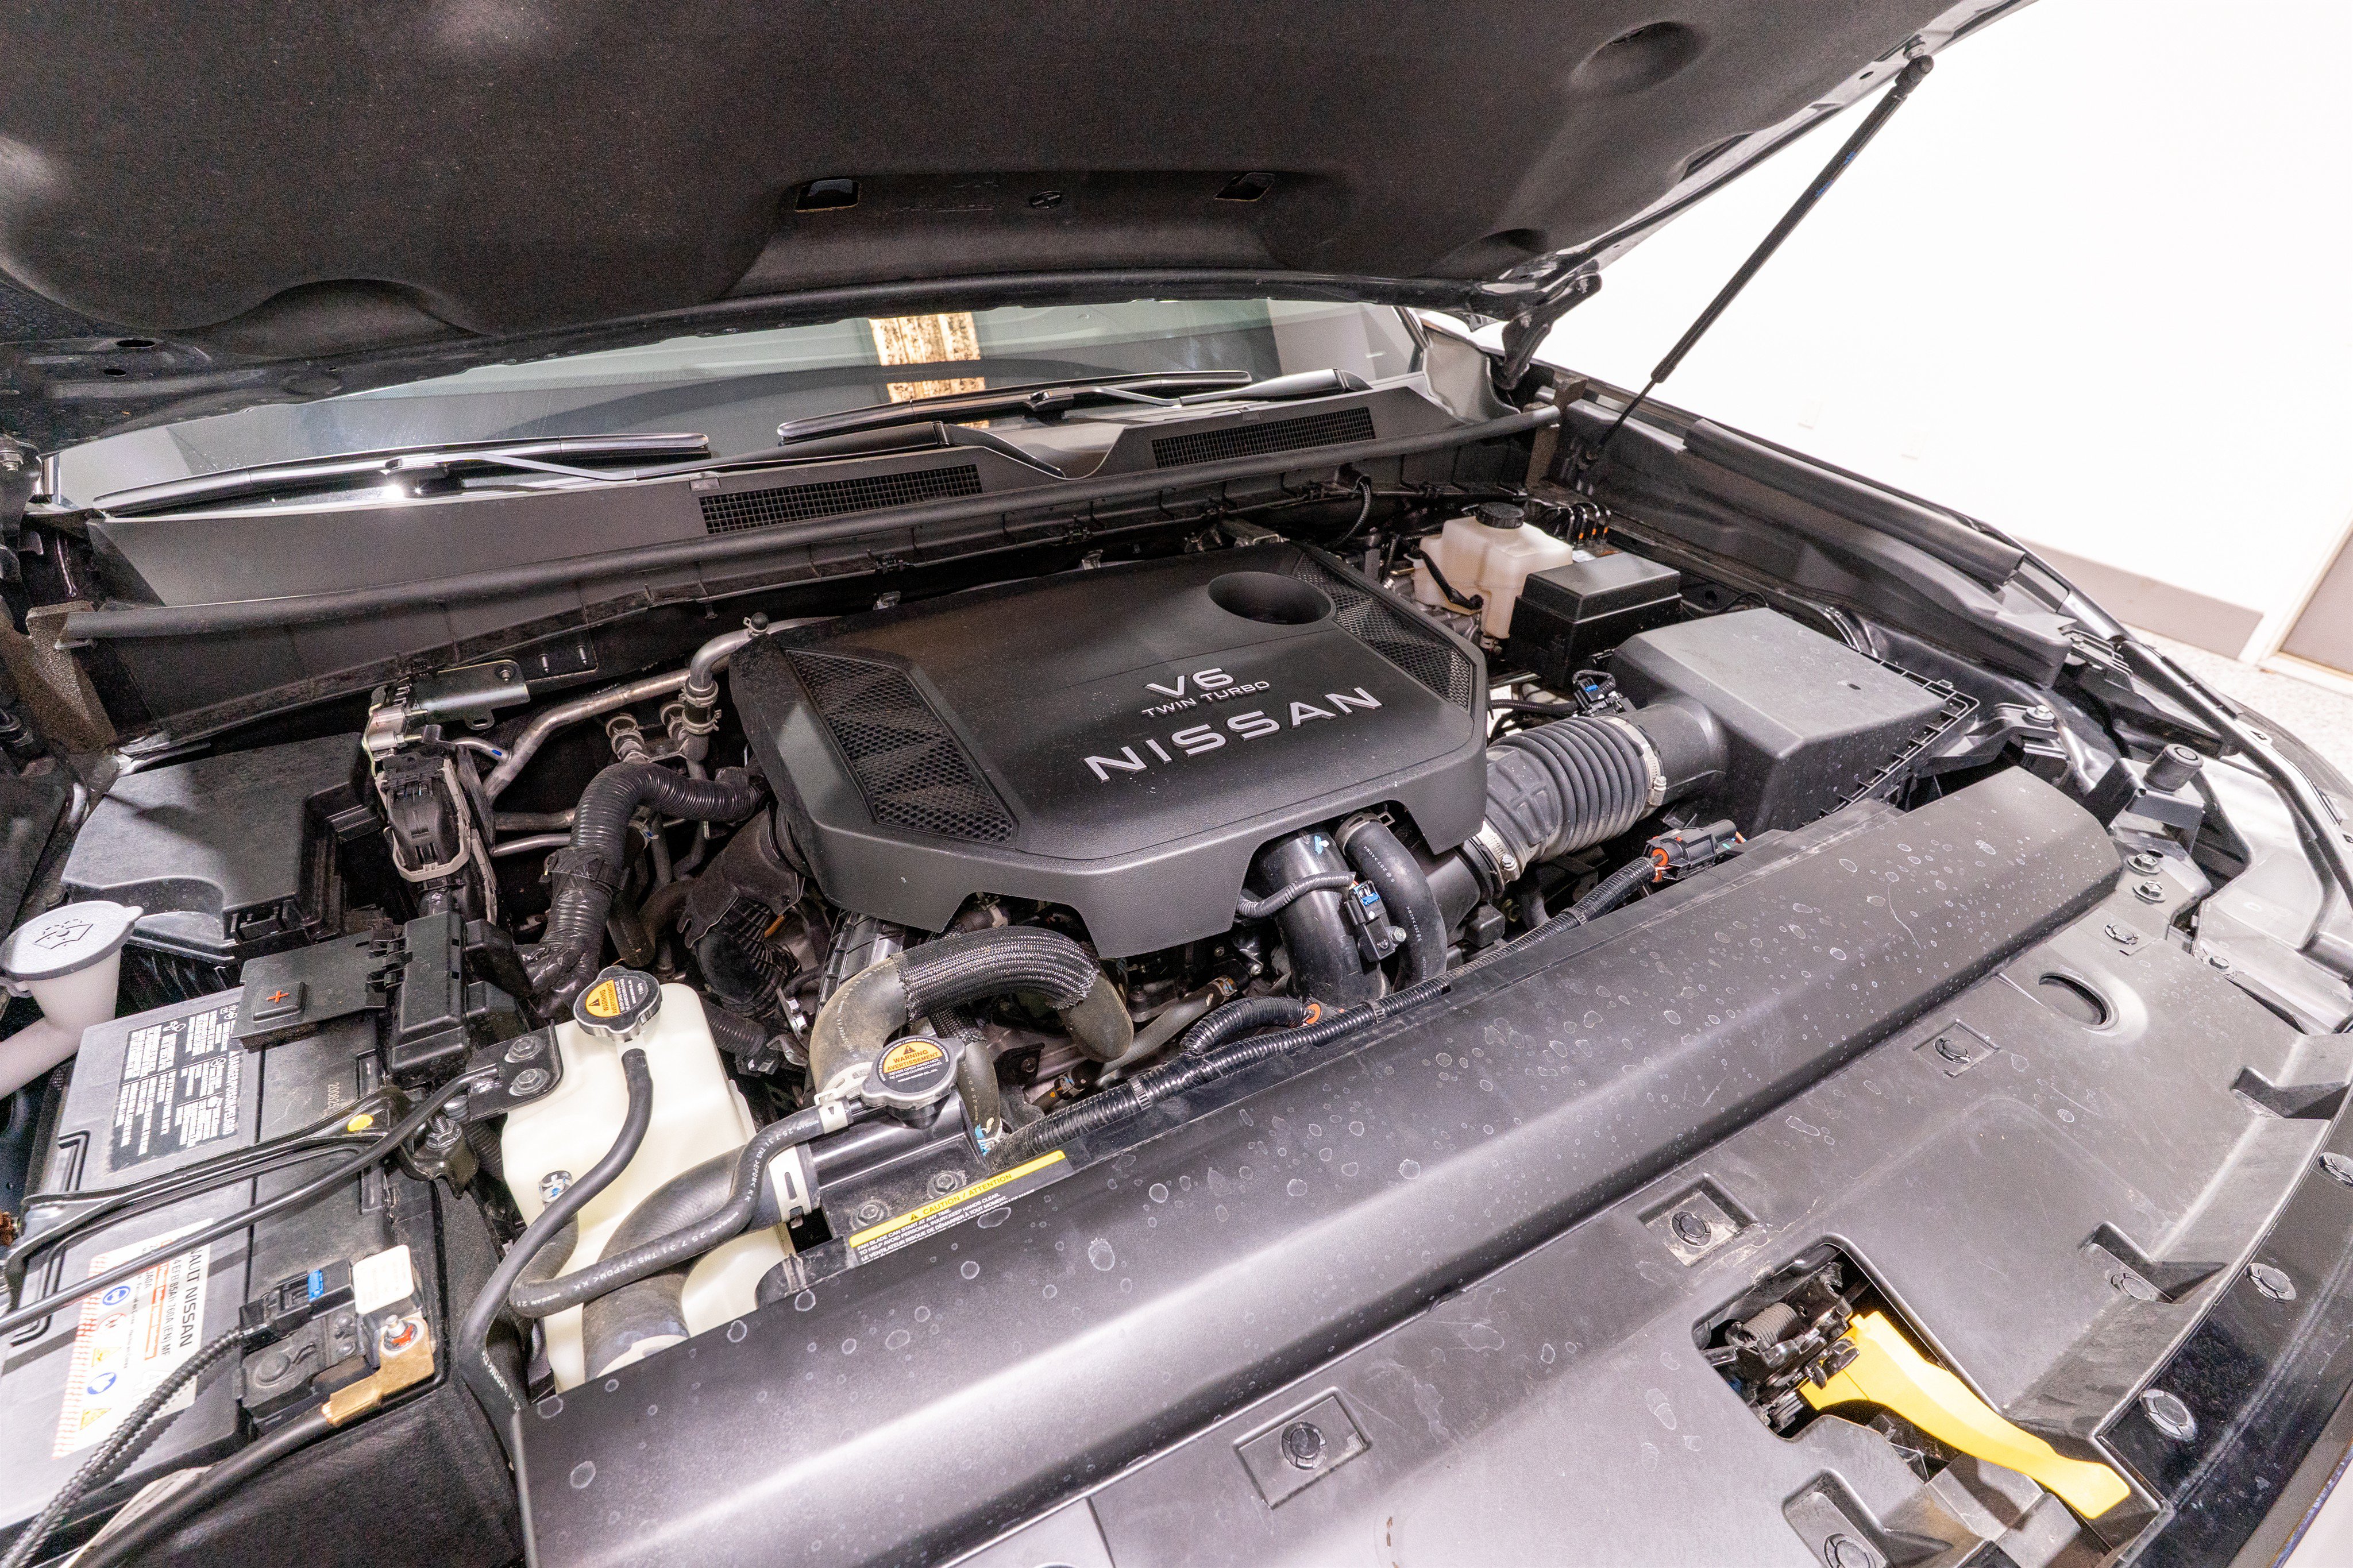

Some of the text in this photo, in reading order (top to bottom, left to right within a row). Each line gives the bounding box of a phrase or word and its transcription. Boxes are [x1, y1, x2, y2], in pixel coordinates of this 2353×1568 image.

[1144, 668, 1235, 698] V6
[1141, 681, 1270, 718] TWIN TURBO
[1083, 688, 1383, 783] NISSAN
[600, 989, 609, 1011] WARNING
[607, 983, 618, 1014] AVERTISSEMENT
[887, 1052, 938, 1071] AVERTISSEMENT
[893, 1049, 928, 1063] WARNING
[327, 1082, 340, 1109] 200825
[783, 1128, 793, 1137] 25
[796, 1119, 819, 1130] NISSAN
[756, 1147, 766, 1159] TNS
[923, 1195, 960, 1215] CAUTION
[969, 1173, 1012, 1196] ATTENTION
[711, 1211, 739, 1234] NISSAN
[857, 1242, 869, 1251] FAN
[869, 1236, 888, 1248] BLADE
[901, 1222, 918, 1232] START
[926, 1213, 939, 1222] ANY
[938, 1208, 952, 1218] TIME.
[859, 1248, 868, 1256] TO
[868, 1242, 883, 1252] HELP
[884, 1235, 901, 1245] AVOID
[901, 1223, 931, 1239] PERSONAL
[962, 1200, 982, 1212] HANDS
[981, 1192, 1001, 1203] CLEAR.
[868, 1239, 906, 1258] VENTILATEUR
[905, 1231, 927, 1243] RISQUE
[935, 1215, 965, 1230] DÉMARRER
[969, 1207, 983, 1216] TOUT
[983, 1195, 1008, 1210] MOMENT.
[692, 1231, 707, 1242] 25
[638, 1252, 658, 1264] TNS
[179, 1249, 203, 1348] NAULT NISSAN
[530, 1292, 561, 1306] NISSAN
[165, 1303, 176, 1324] 760A
[161, 1325, 172, 1344] (EN)
